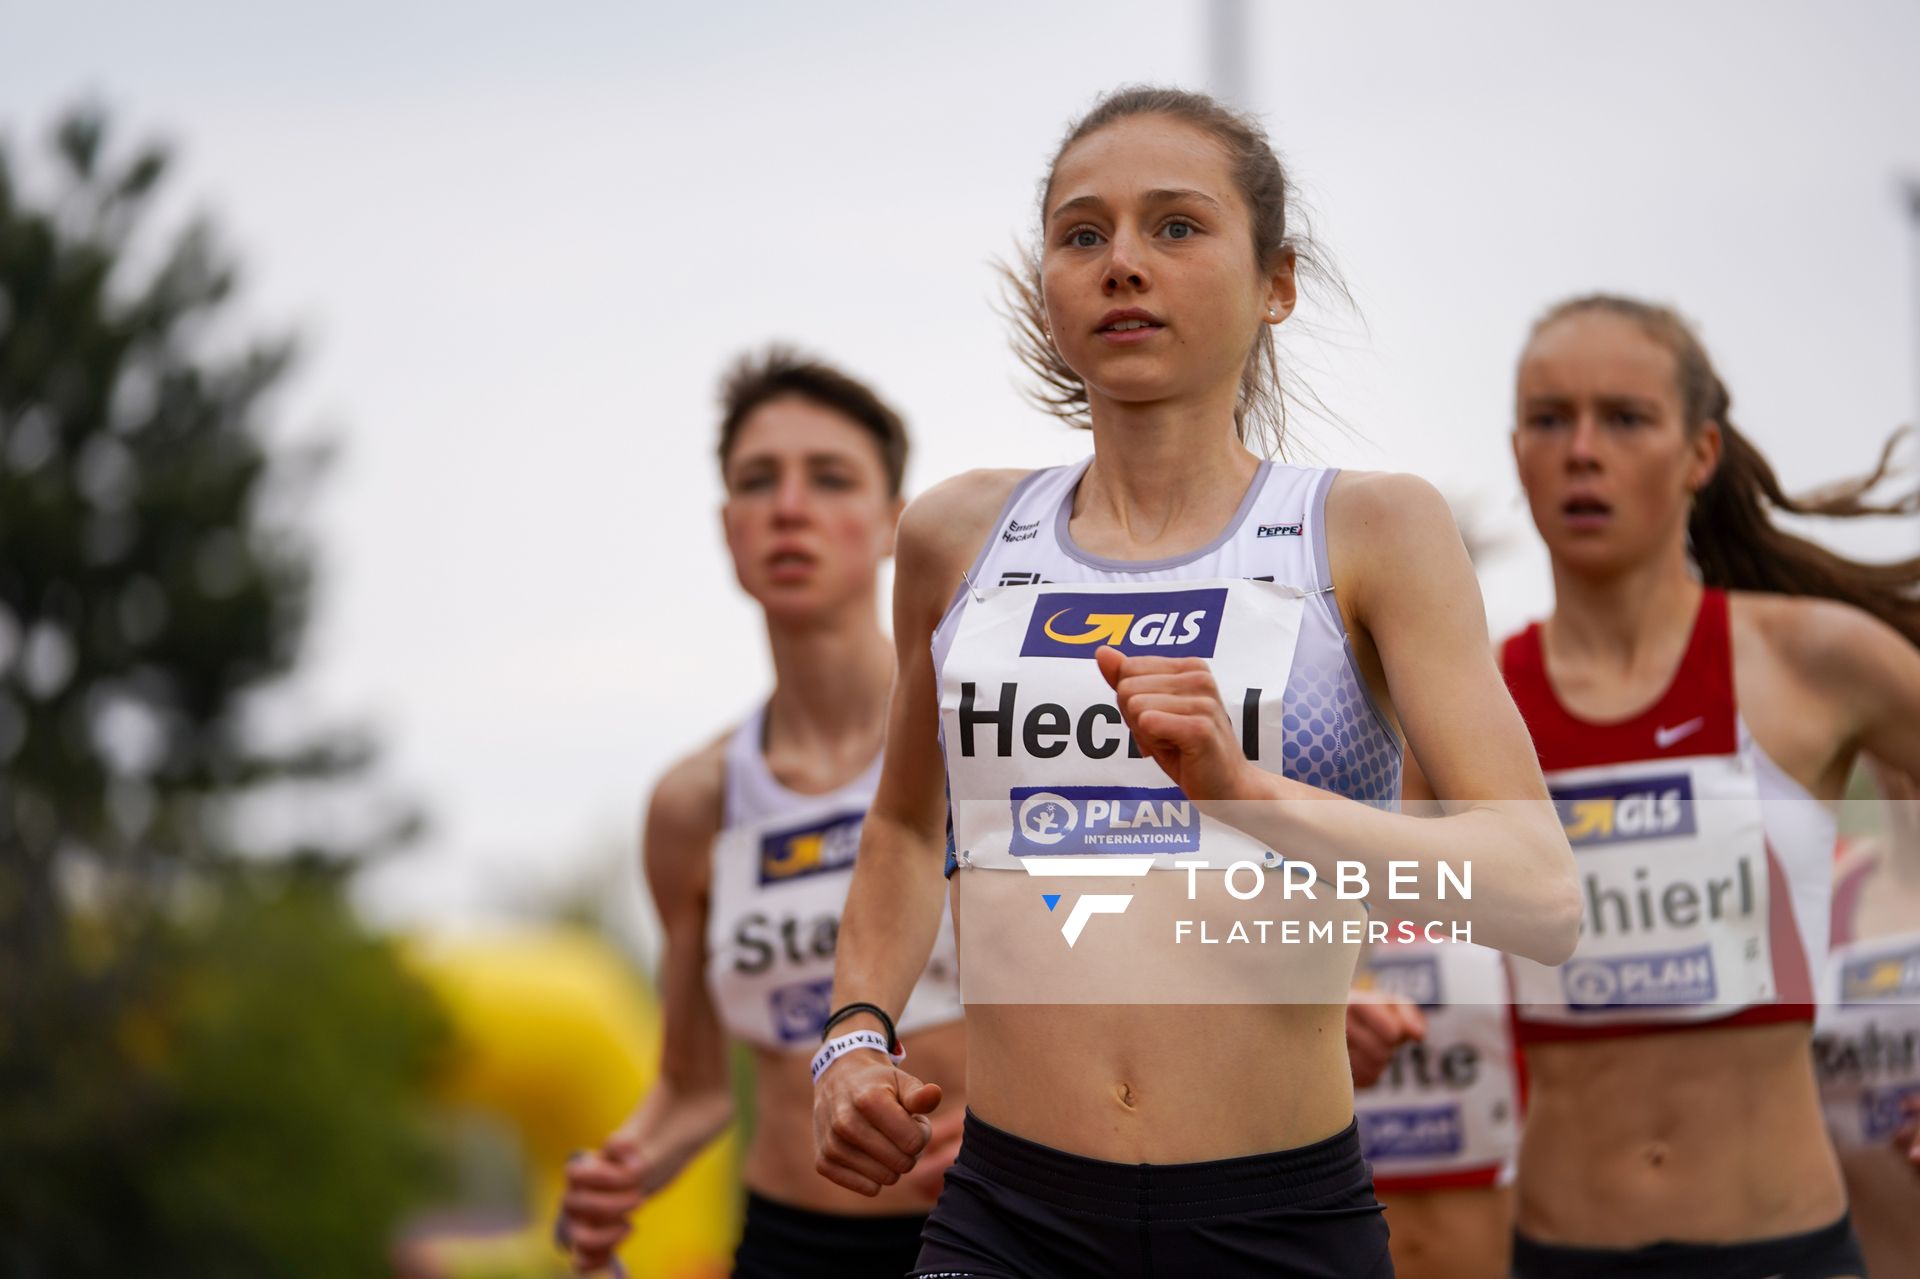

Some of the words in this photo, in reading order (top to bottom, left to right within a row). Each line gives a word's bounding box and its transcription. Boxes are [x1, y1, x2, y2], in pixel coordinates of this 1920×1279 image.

[1129, 610, 1206, 646] GLS
[959, 682, 1262, 760] Hecl
[1085, 800, 1191, 829] PLAN
[1615, 788, 1681, 836] GLS
[1084, 833, 1191, 846] INTERNATIONAL
[1579, 856, 1757, 937] hierl
